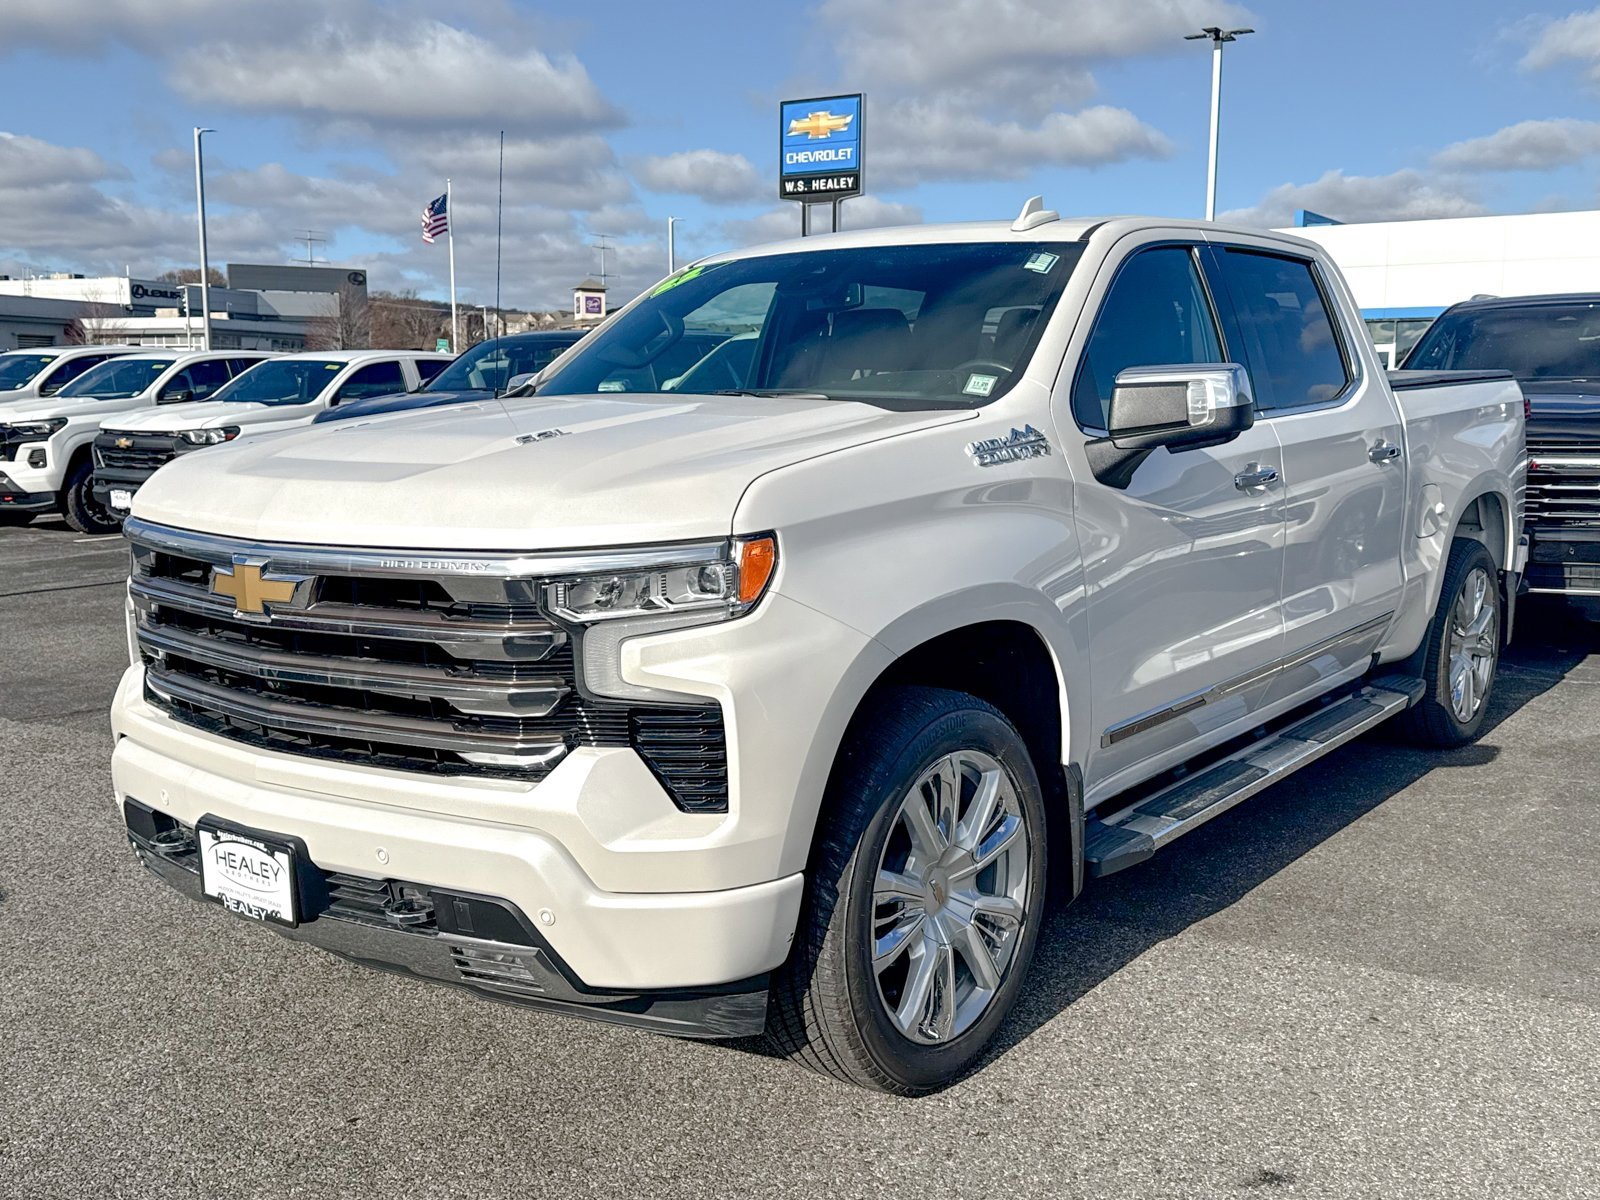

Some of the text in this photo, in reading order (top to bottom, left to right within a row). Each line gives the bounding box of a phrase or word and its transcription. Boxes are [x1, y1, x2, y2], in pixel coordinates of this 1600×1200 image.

[785, 147, 853, 165] CHEVROLET
[784, 176, 854, 193] W.S. HEALEY
[419, 561, 490, 571] COUNTRY
[215, 848, 280, 882] HEALEY
[223, 894, 267, 921] HEALEY
